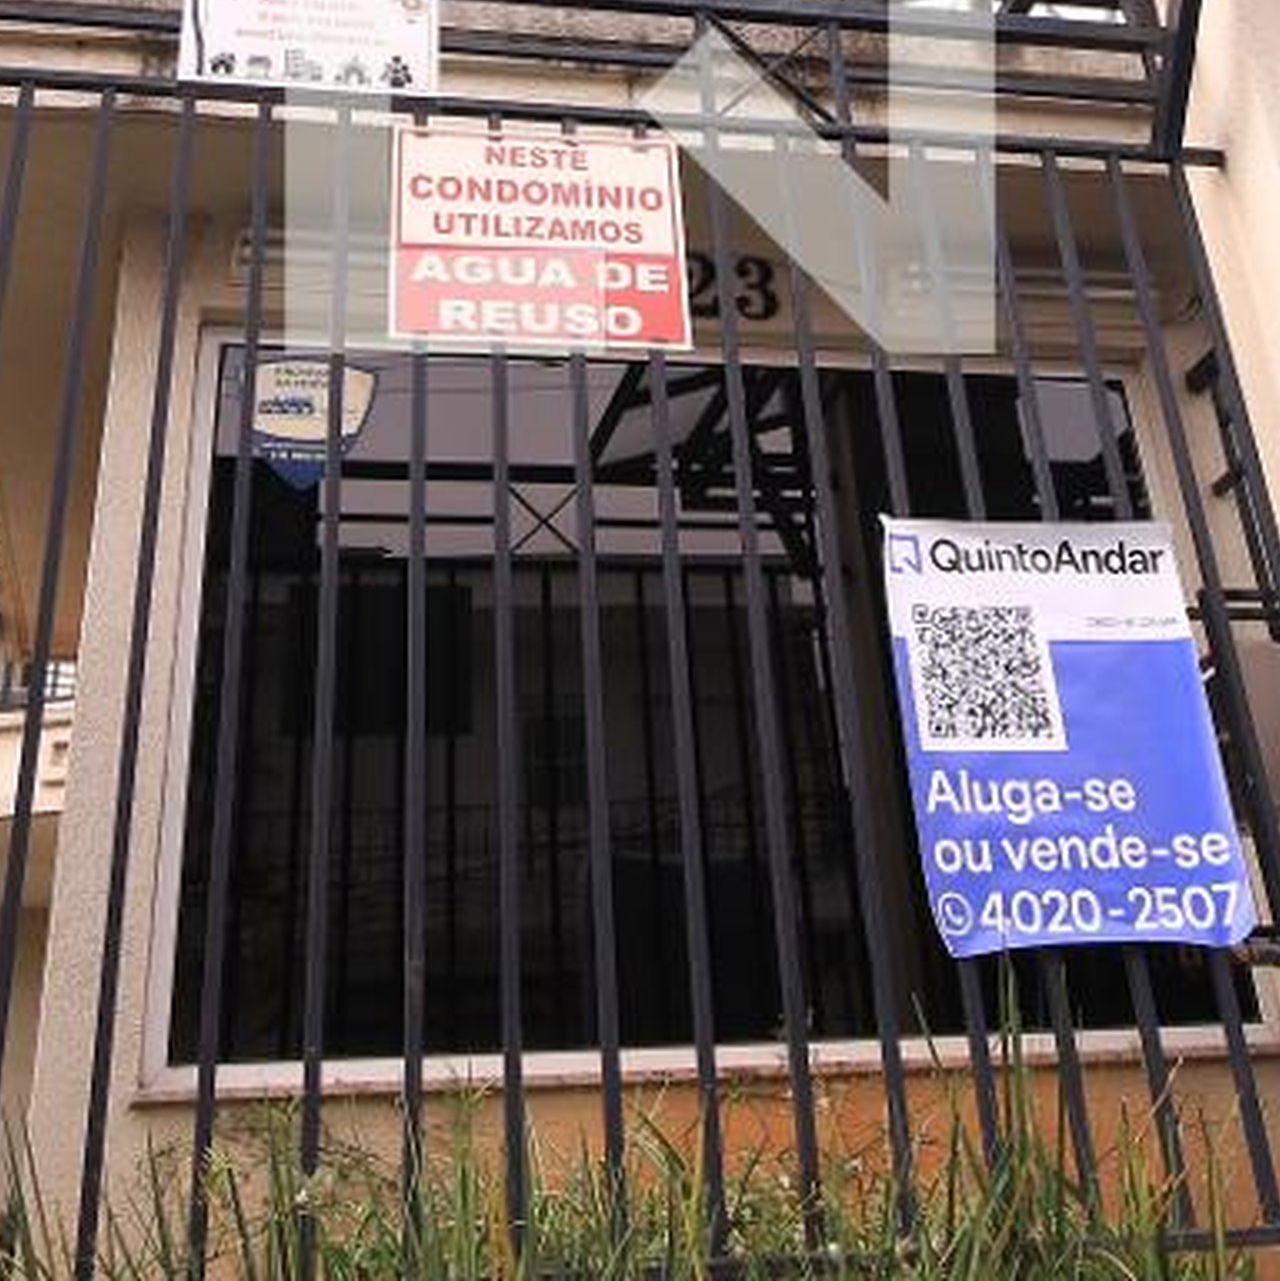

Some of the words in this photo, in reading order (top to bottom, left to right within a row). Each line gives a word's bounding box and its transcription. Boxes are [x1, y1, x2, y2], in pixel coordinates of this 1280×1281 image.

[484, 146, 589, 171] NESTE
[409, 174, 664, 212] CONDOMÍNIO
[433, 212, 644, 244] UTILIZAMOS
[410, 254, 576, 288] AGUA
[595, 262, 670, 293] DE
[437, 298, 644, 337] REUSO
[929, 538, 1166, 575] QuintoAndar
[927, 769, 1136, 823] Aluga-se
[933, 838, 993, 873] ou
[1001, 825, 1233, 872] vende-se
[981, 882, 1240, 935] 4020-2507
